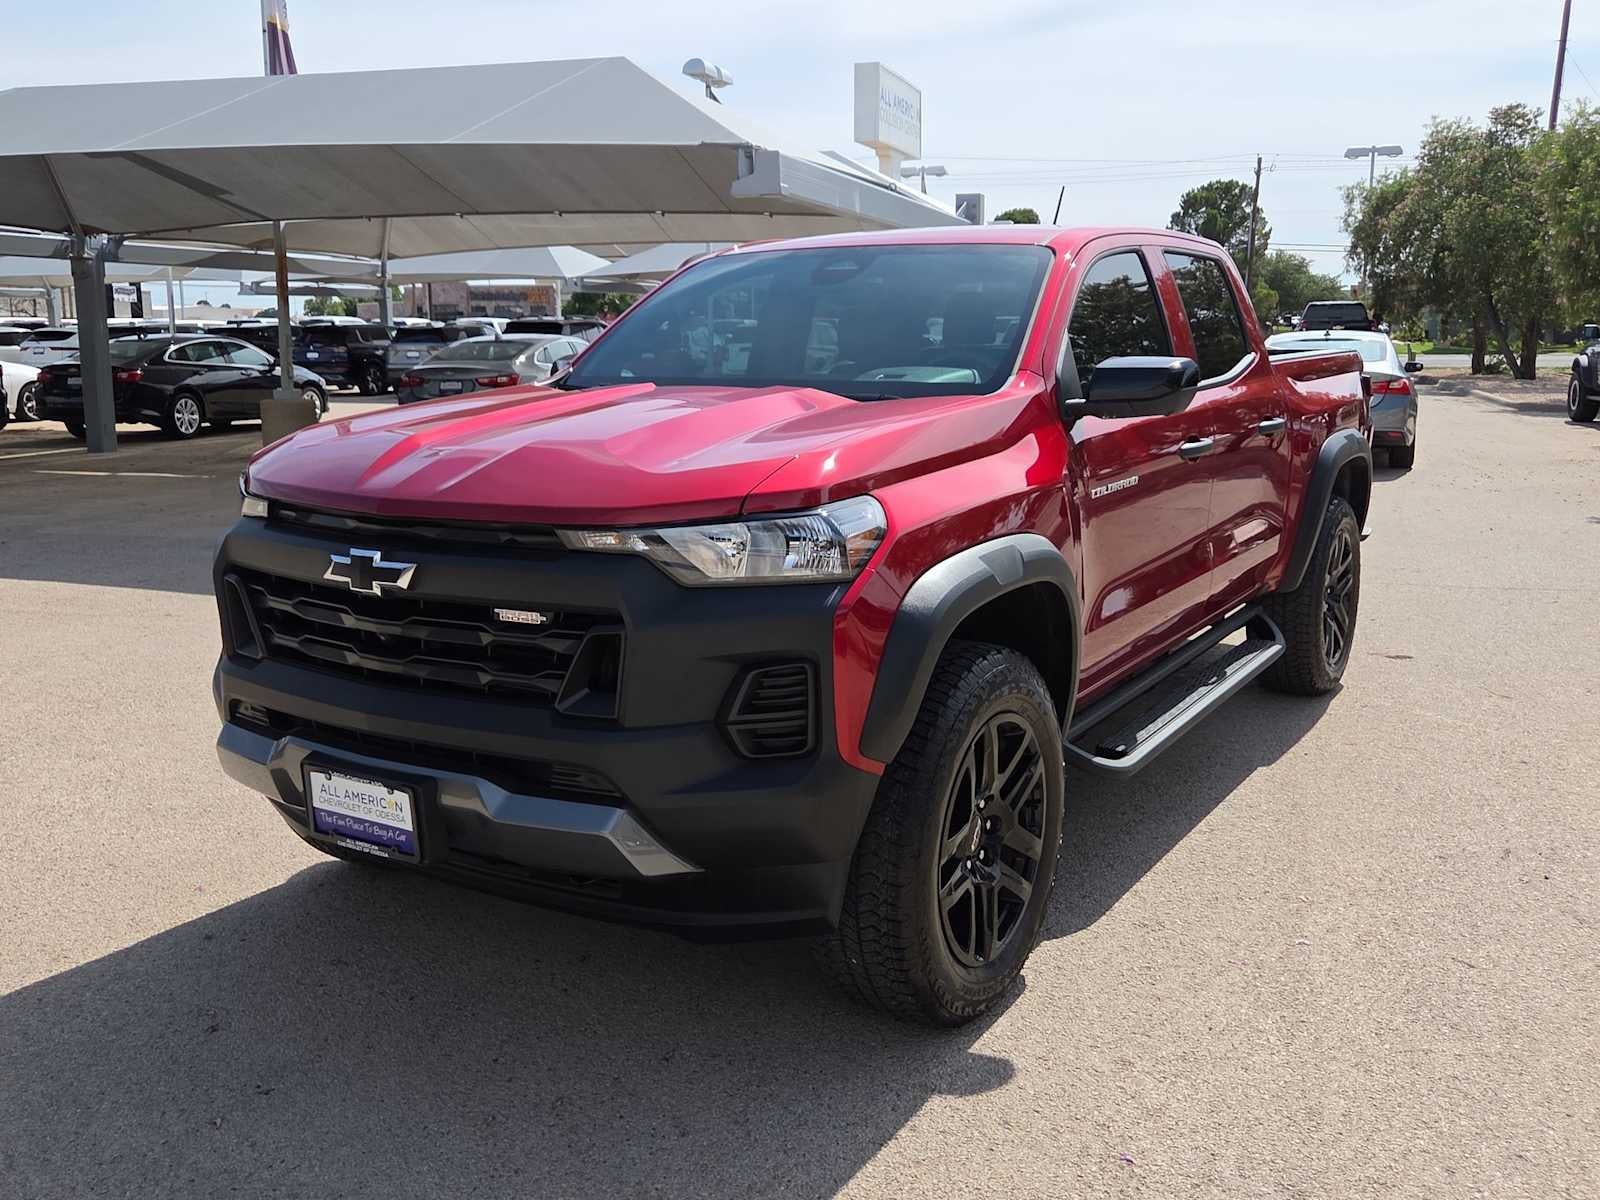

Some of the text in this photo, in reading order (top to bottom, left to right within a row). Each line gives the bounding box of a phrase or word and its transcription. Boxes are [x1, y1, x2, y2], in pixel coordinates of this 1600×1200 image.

[893, 94, 920, 123] AMERIC
[1091, 475, 1139, 499] COLORADO
[319, 784, 340, 798] ALL
[318, 796, 407, 824] CHEVROLET OF ODESSA
[365, 822, 373, 833] To
[388, 830, 394, 839] A
